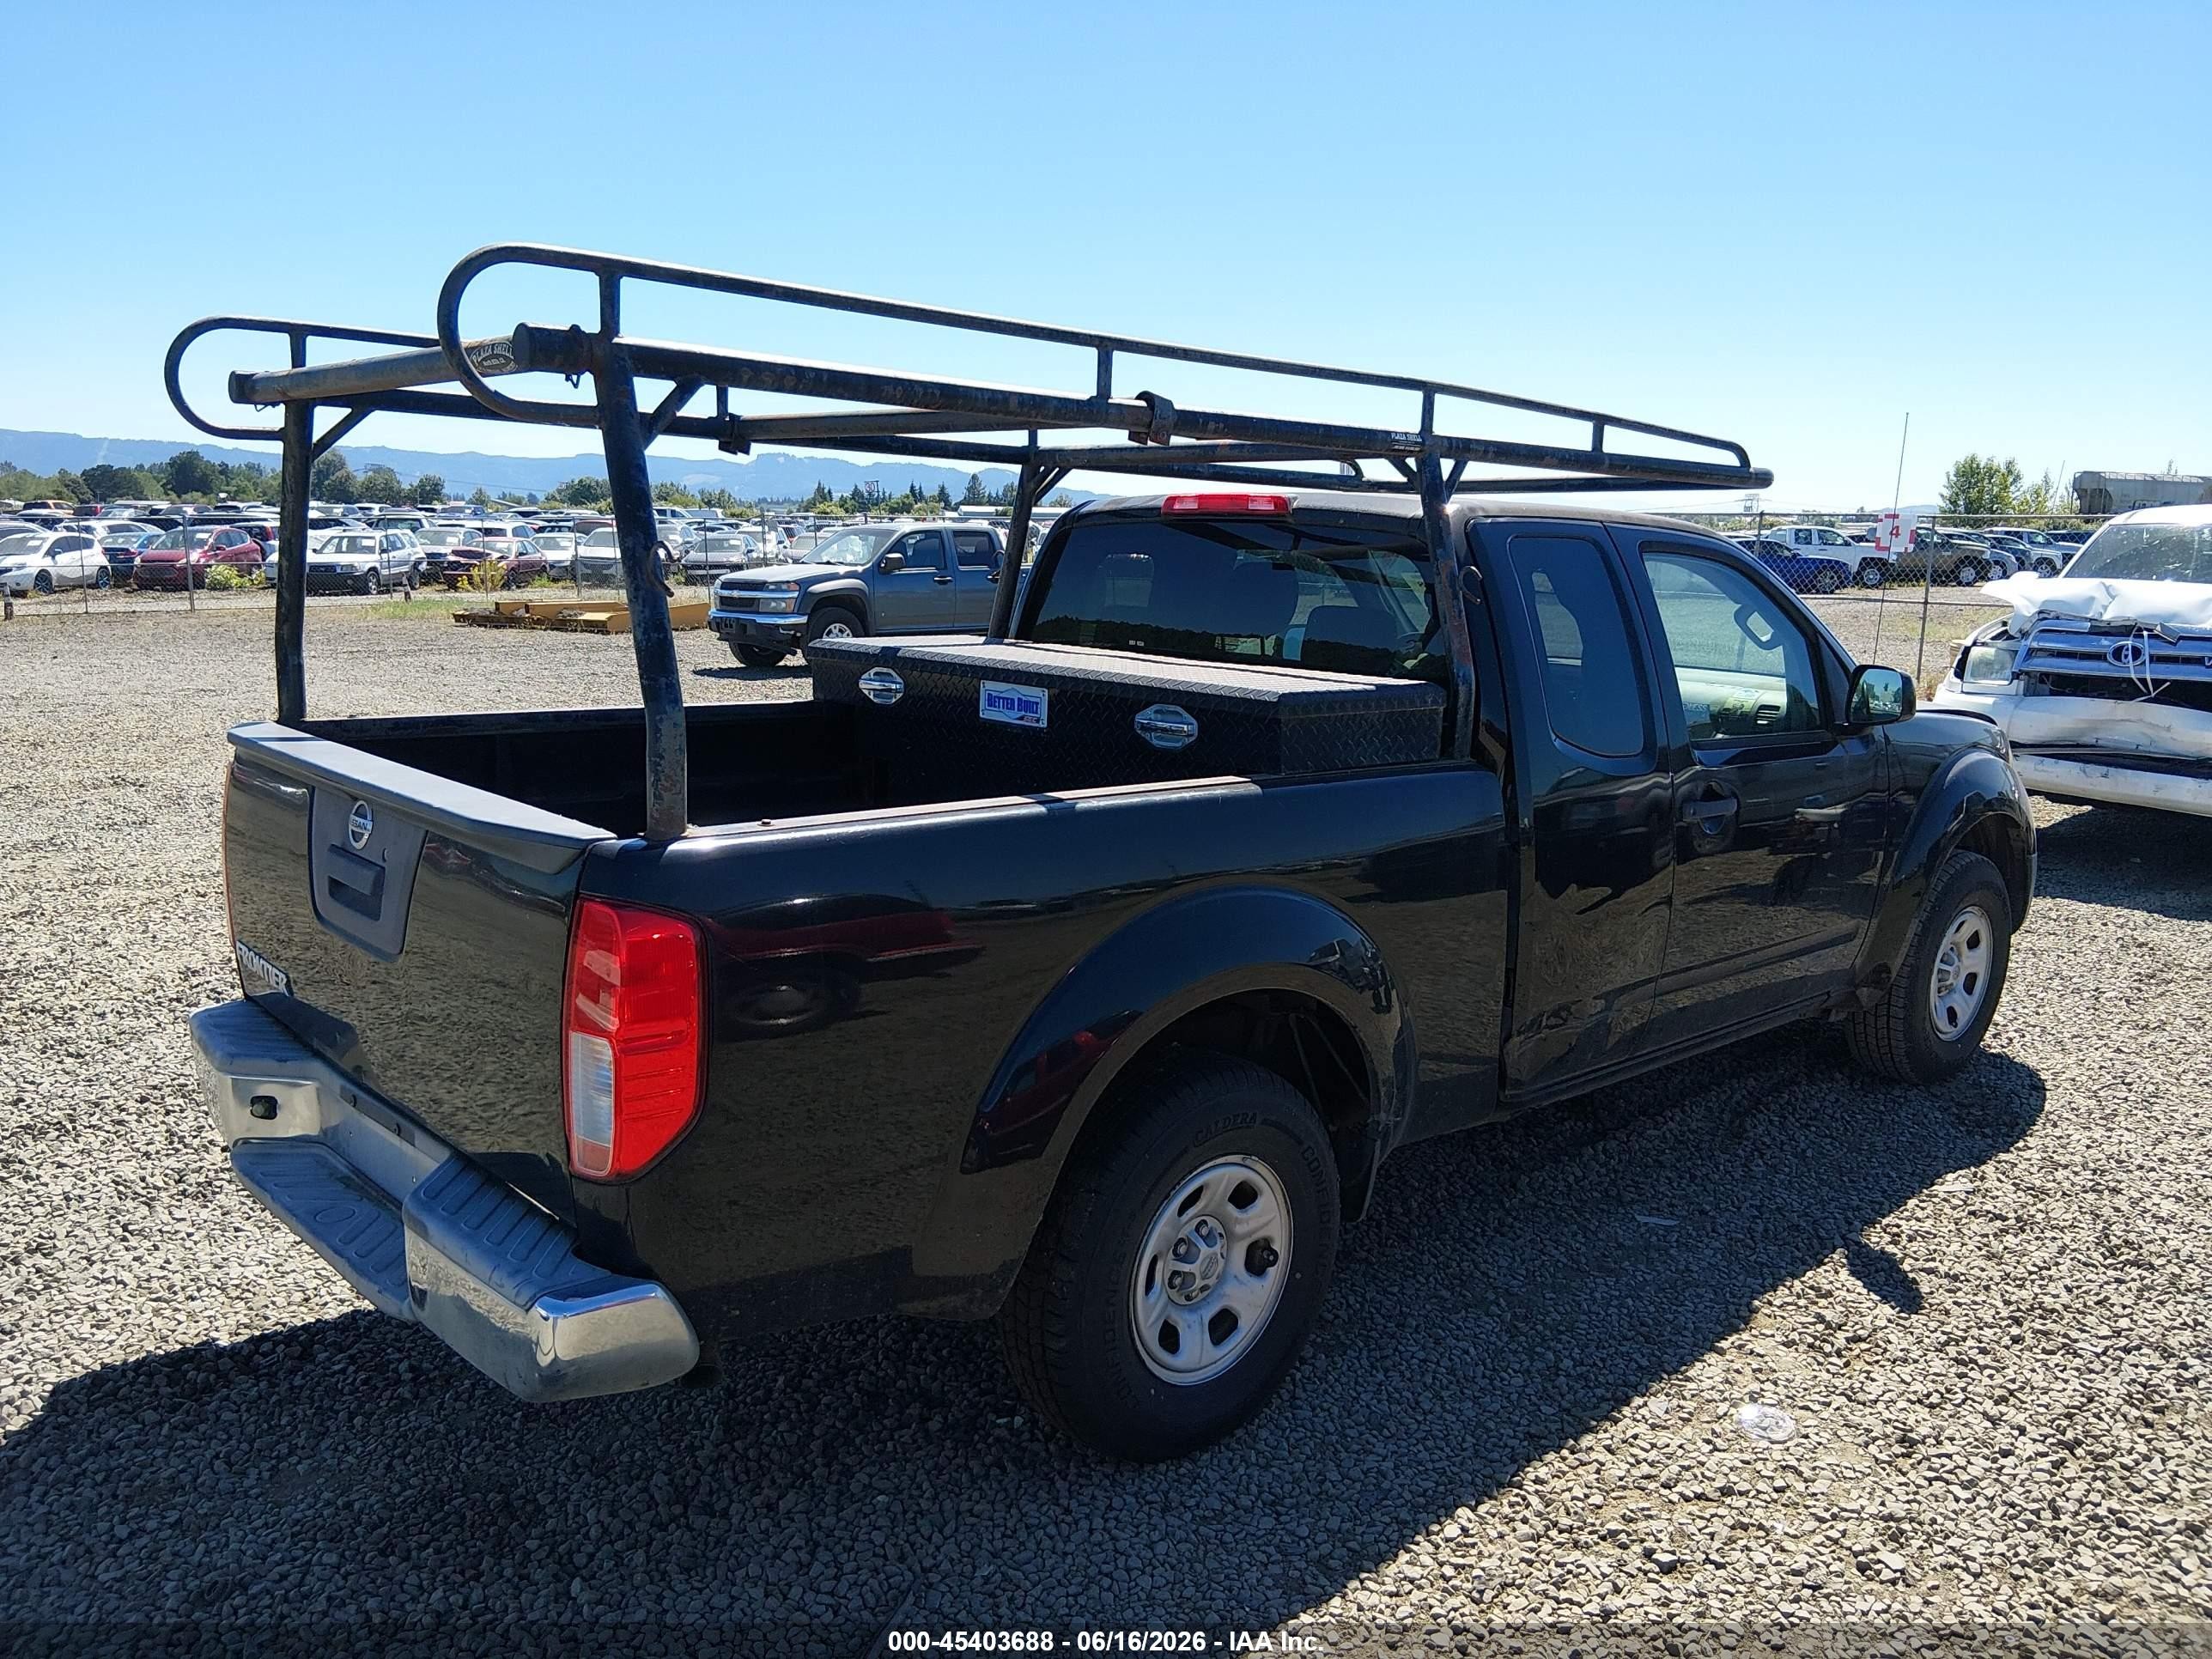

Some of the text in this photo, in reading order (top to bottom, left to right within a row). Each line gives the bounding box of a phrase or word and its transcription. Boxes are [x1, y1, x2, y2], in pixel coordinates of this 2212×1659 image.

[471, 344, 492, 365] PLAZA
[493, 343, 514, 359] SHELL
[1889, 526, 1901, 538] 4
[987, 692, 1040, 715] BETTER BUILT
[236, 940, 289, 996] FRONTIER
[1194, 1112, 1257, 1143] CALDERA
